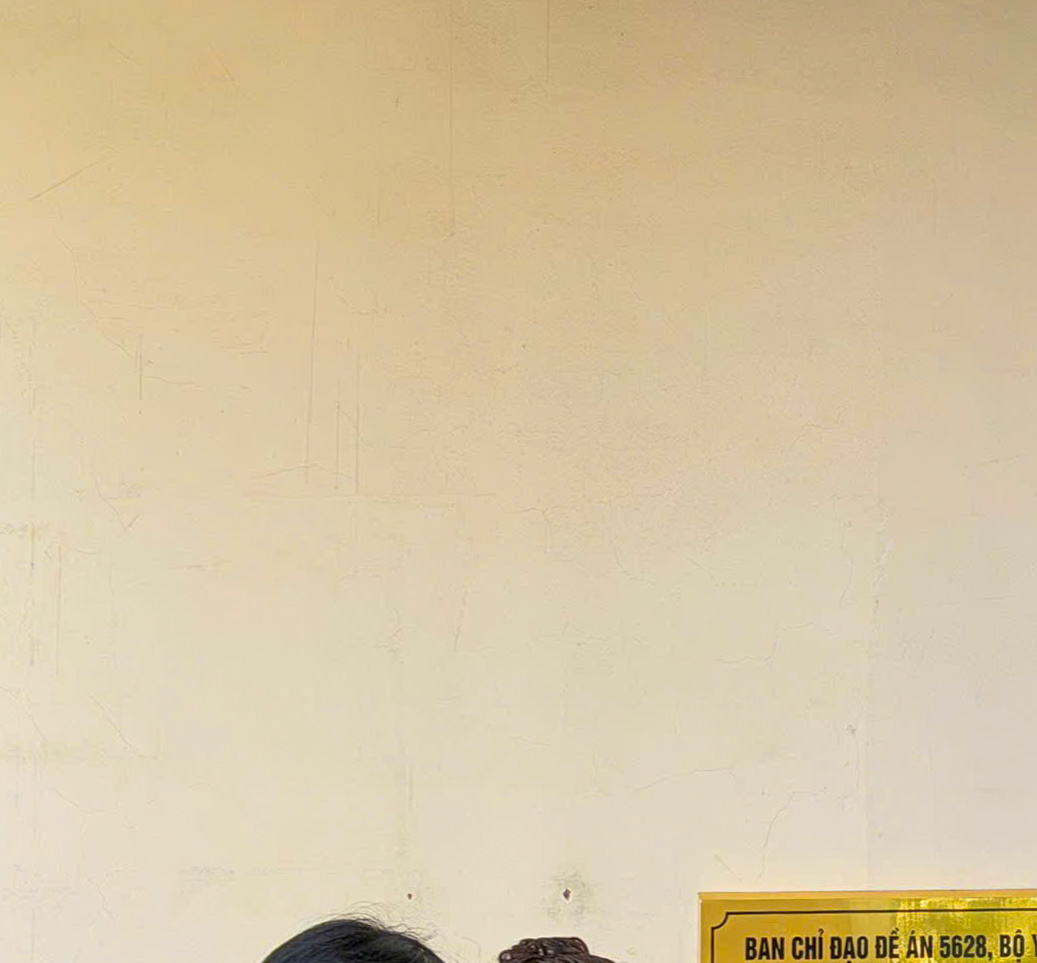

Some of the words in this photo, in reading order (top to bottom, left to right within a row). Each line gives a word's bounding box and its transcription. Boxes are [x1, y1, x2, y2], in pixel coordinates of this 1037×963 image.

[745, 937, 785, 960] BAN
[791, 928, 824, 960] CHỈ
[875, 927, 900, 959] ĐỀ
[906, 930, 933, 958] ÁN
[939, 934, 993, 961] 5628,
[999, 929, 1025, 963] BỘ
